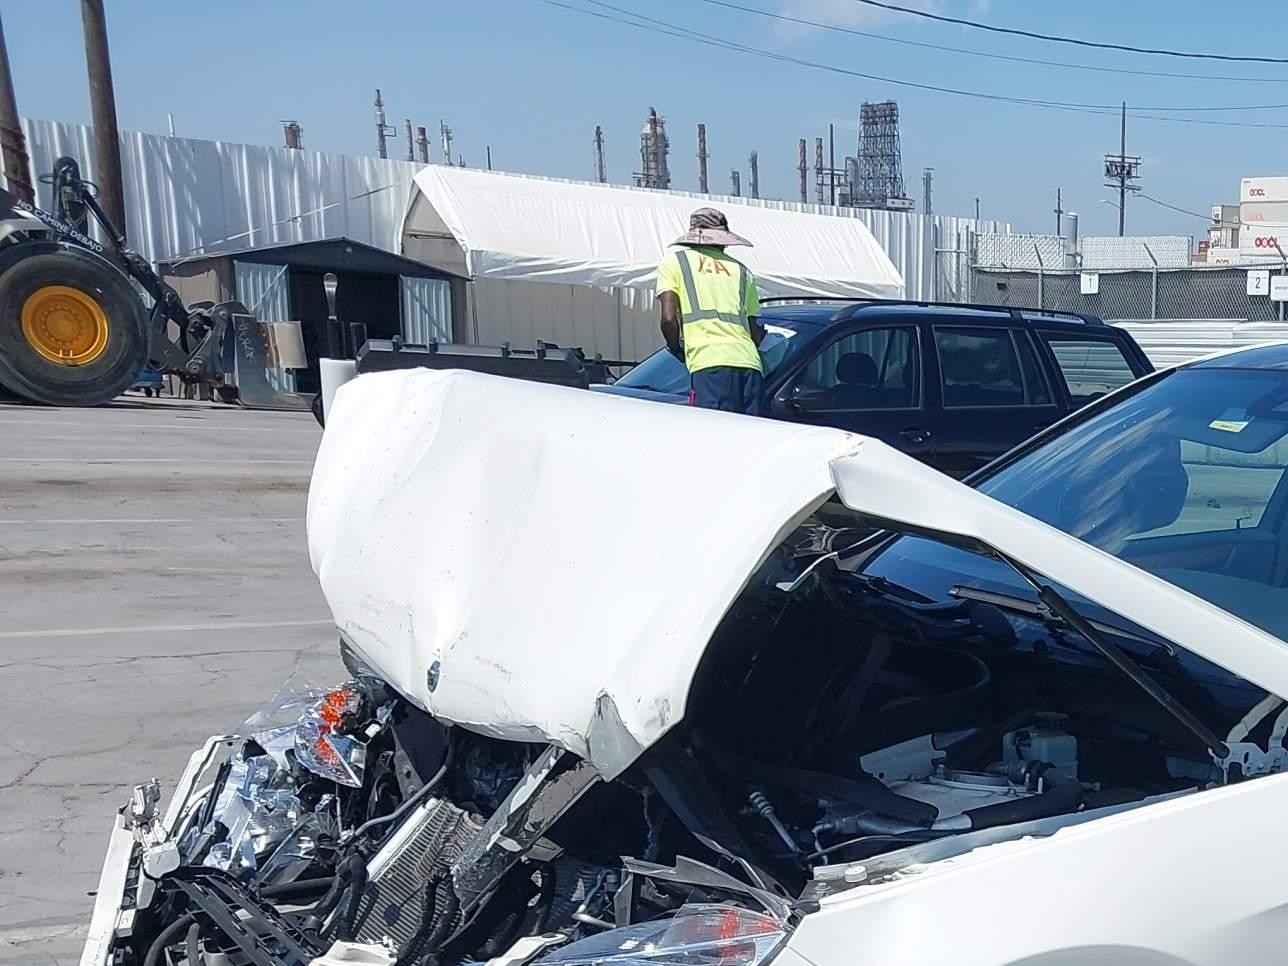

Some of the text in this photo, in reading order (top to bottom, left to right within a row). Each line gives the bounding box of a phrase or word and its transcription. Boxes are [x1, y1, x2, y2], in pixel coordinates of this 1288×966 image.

[16, 199, 104, 252] NO CAMINE DEBAJO
[1255, 277, 1261, 289] 2
